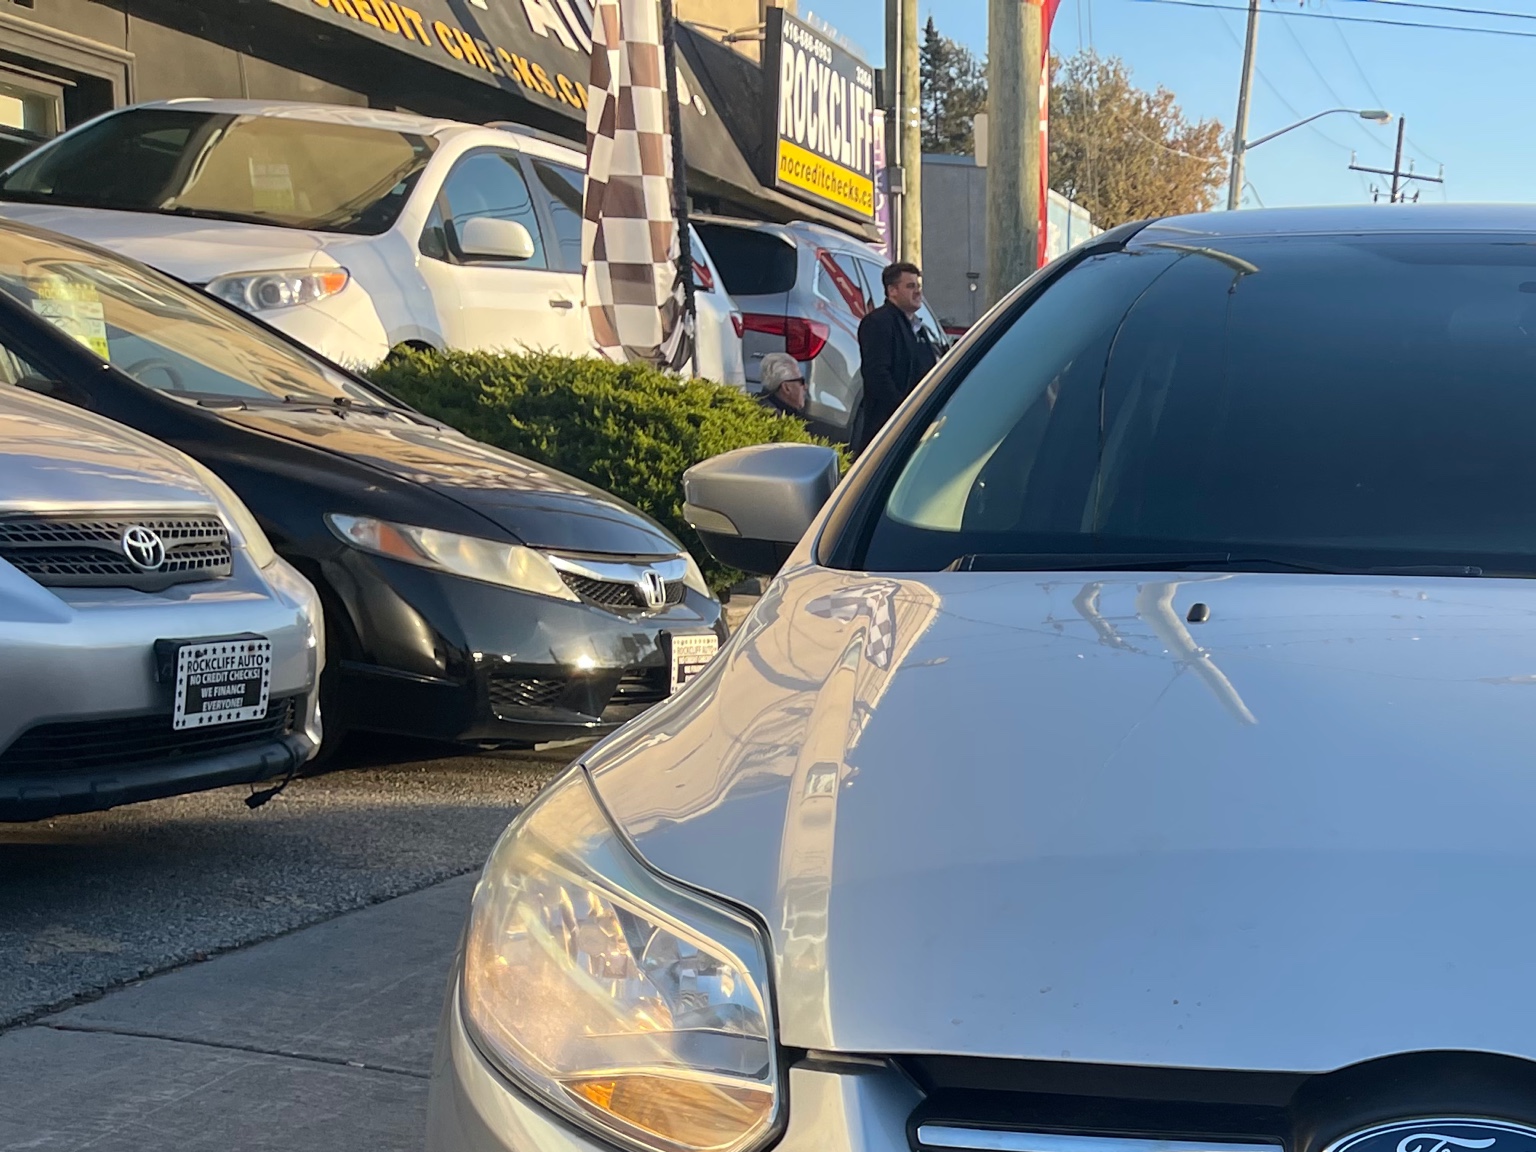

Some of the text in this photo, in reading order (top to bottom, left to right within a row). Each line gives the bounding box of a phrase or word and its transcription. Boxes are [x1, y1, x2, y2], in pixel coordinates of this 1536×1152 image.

[312, 0, 432, 47] REDIT
[780, 41, 873, 175] ROCKCLIFF
[780, 153, 872, 208] nocreditchecks.ca
[187, 654, 264, 674] ROCKCLIFF AUTO
[190, 668, 260, 686] NO CREDIT CHECKS!
[201, 683, 246, 698] WE FINANCE
[203, 697, 243, 712] EVERYONE!
